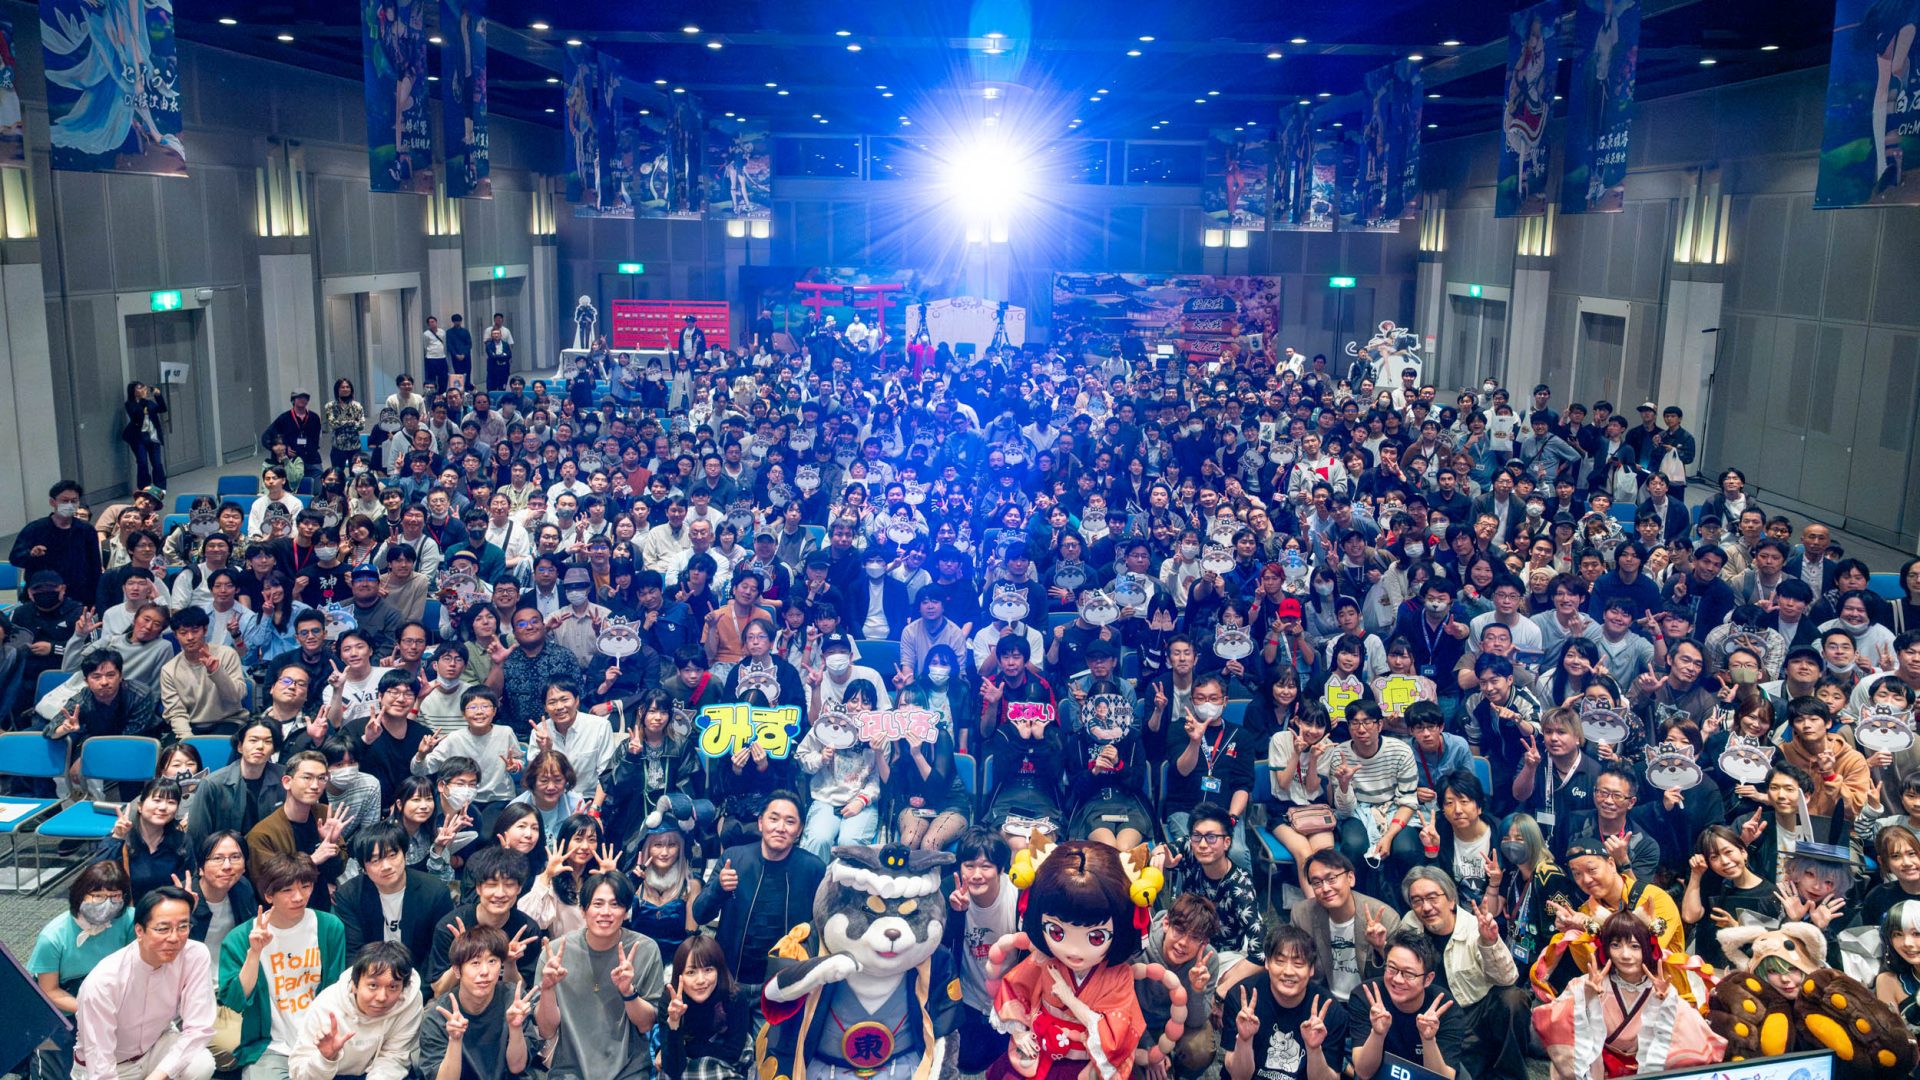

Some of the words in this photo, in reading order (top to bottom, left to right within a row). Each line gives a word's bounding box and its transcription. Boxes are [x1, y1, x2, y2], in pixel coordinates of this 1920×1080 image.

[121, 63, 179, 93] セイラン
[702, 705, 799, 757] みず
[1571, 786, 1587, 798] Gap
[852, 1033, 884, 1060] 東
